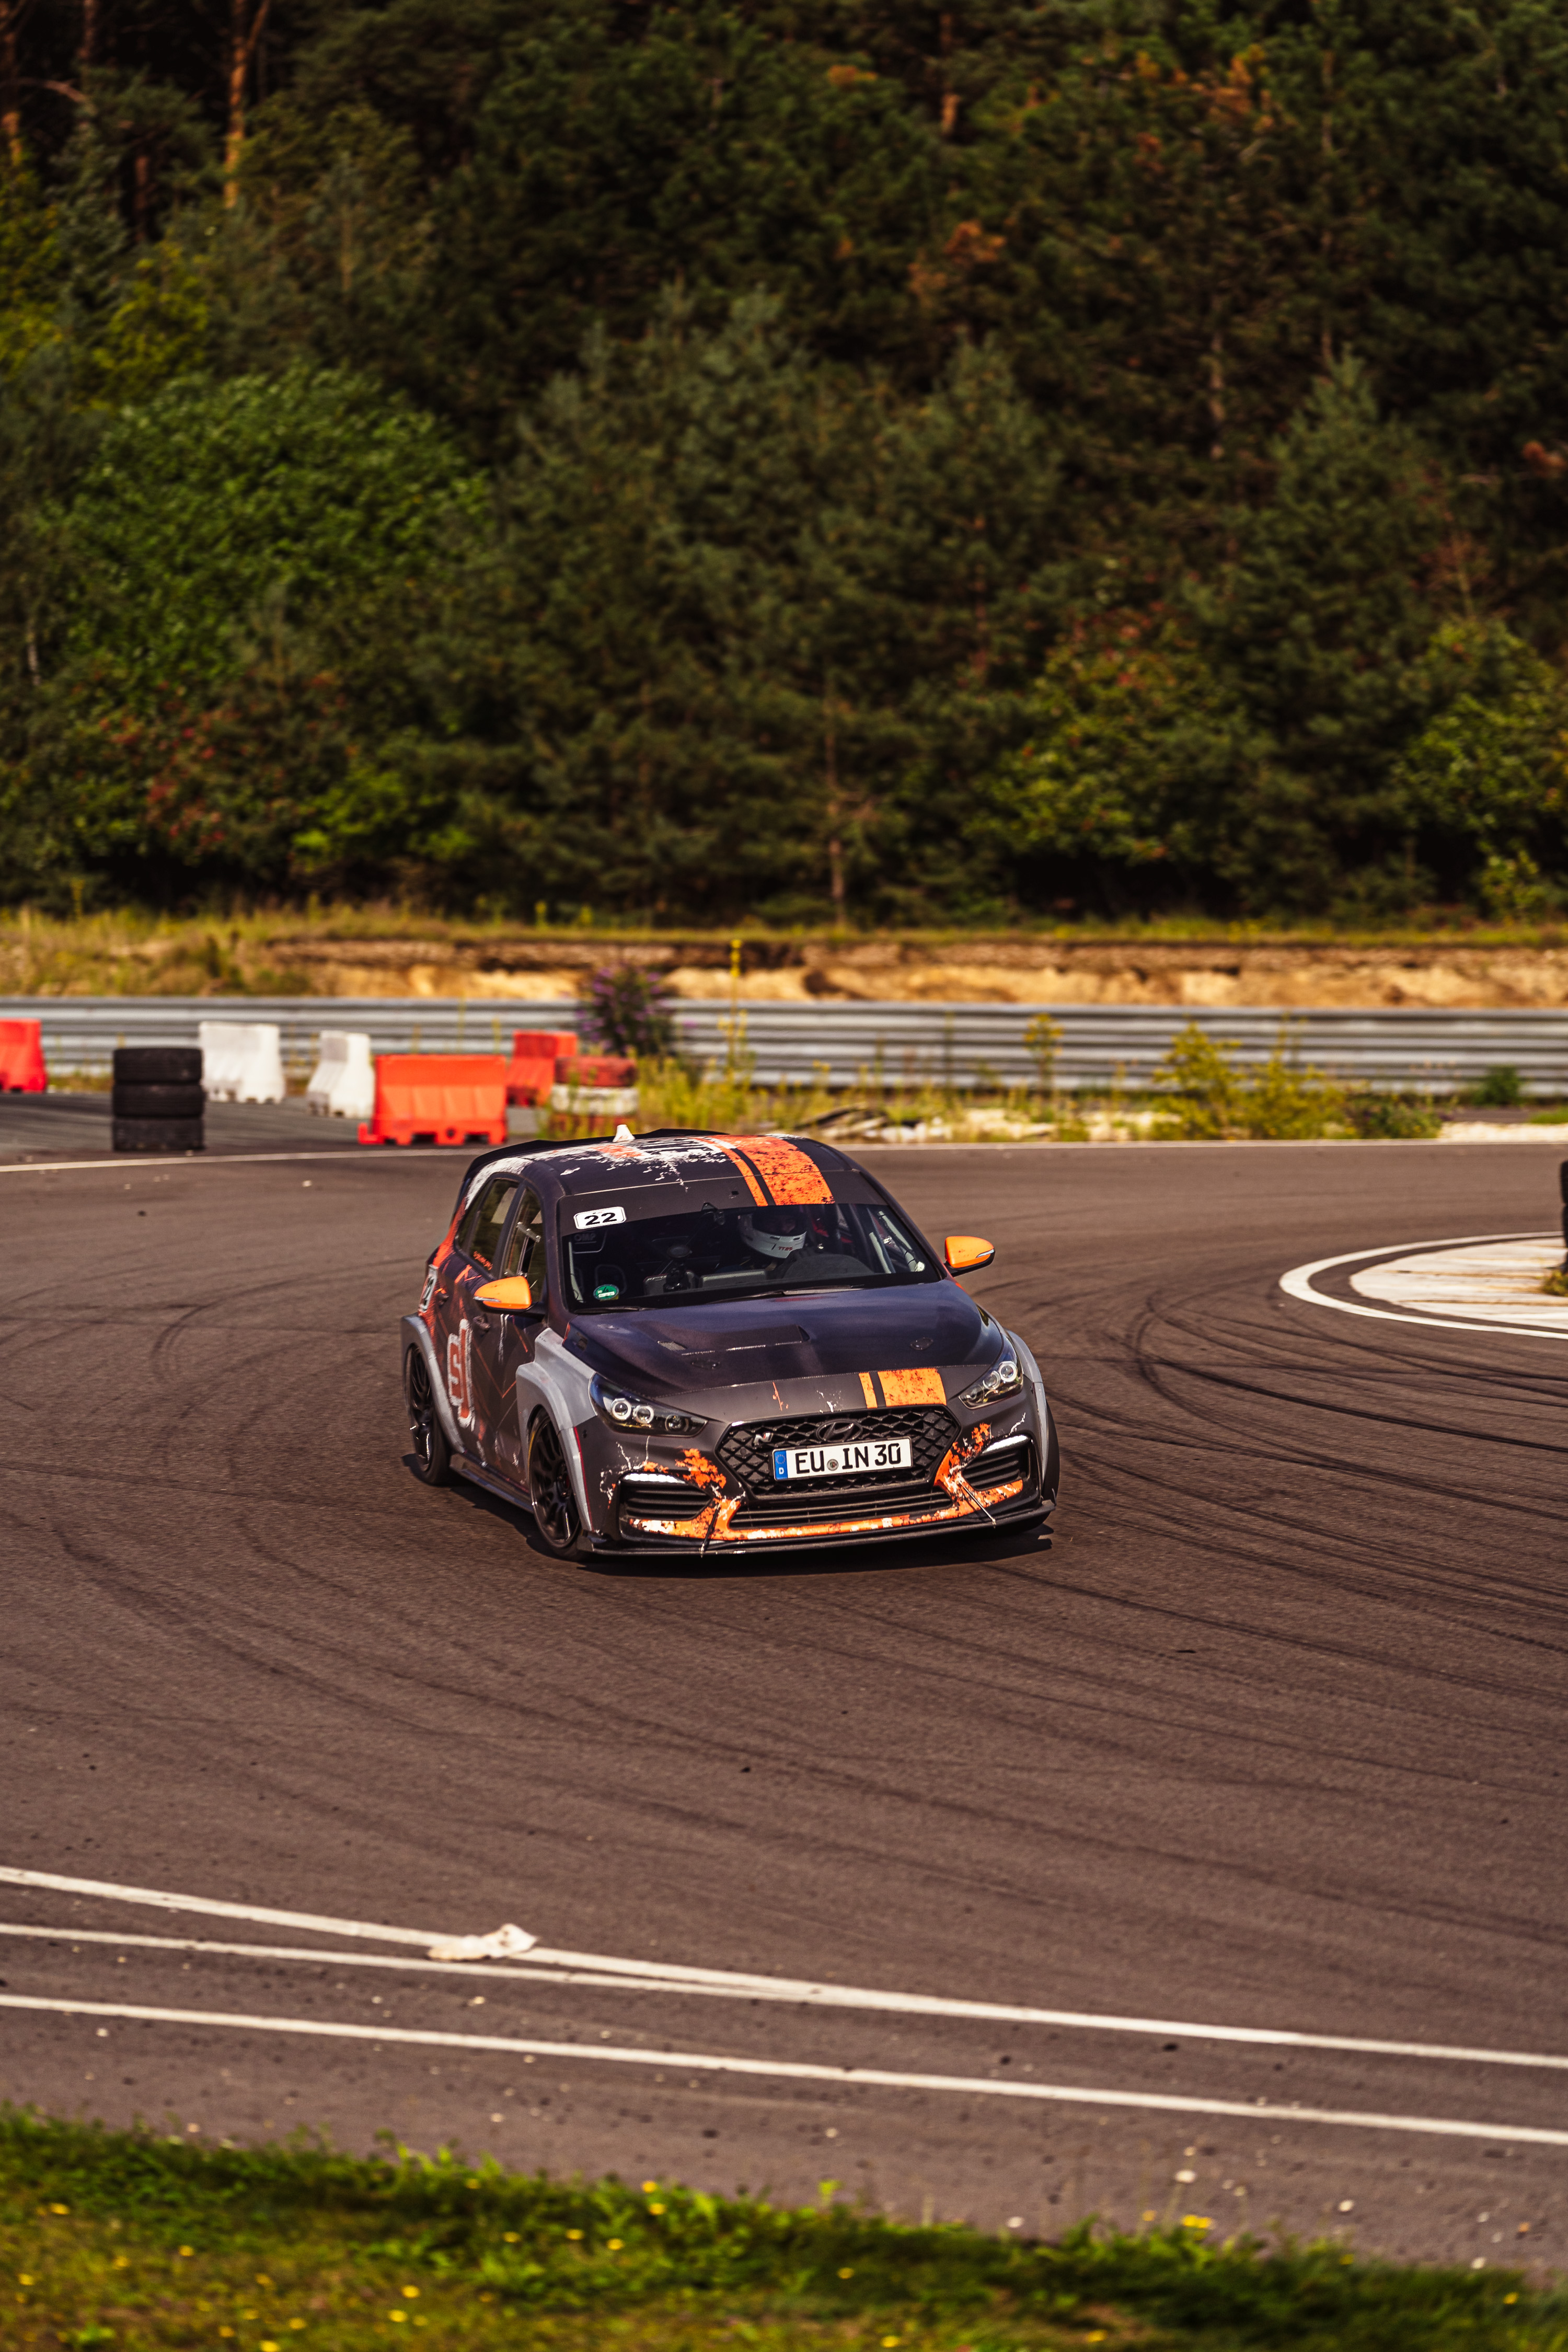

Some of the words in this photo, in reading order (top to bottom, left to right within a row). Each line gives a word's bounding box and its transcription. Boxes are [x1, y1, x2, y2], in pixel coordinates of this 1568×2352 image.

[584, 1213, 617, 1226] 22
[795, 1450, 825, 1474] EU
[842, 1446, 870, 1470] IN
[874, 1443, 902, 1466] 30
